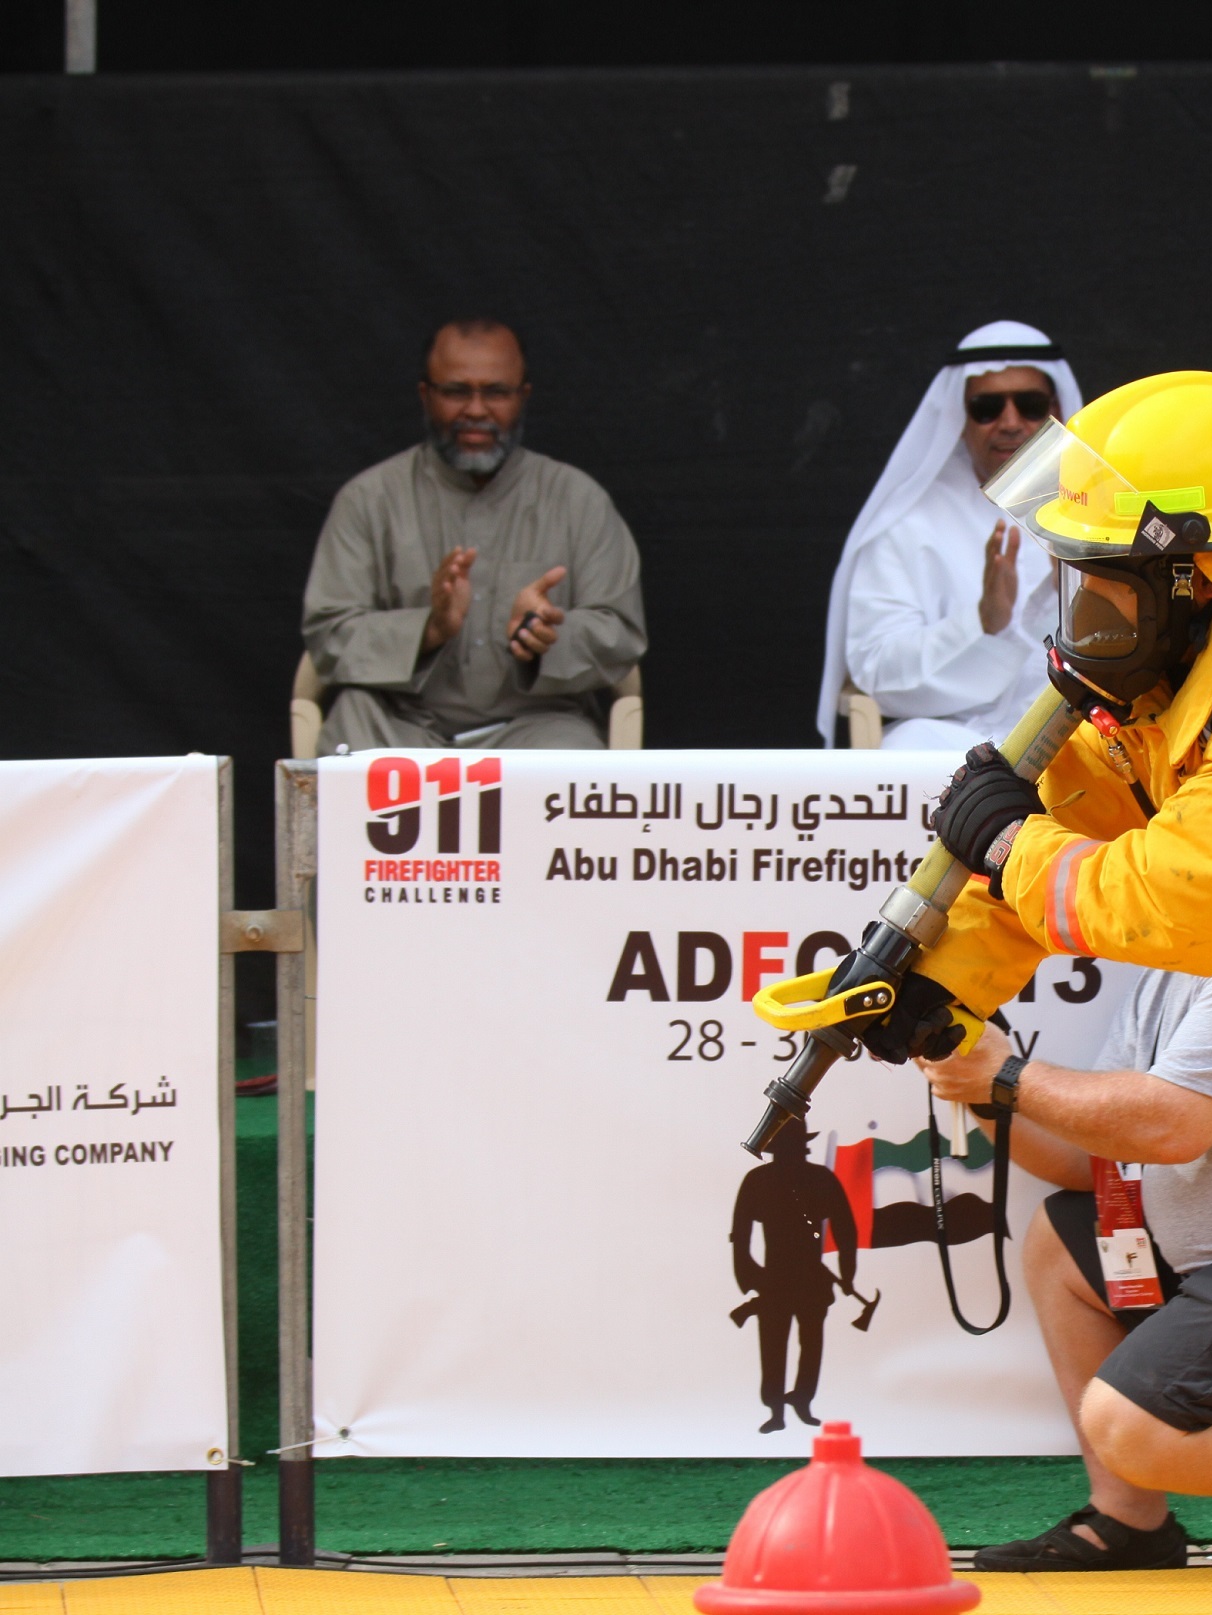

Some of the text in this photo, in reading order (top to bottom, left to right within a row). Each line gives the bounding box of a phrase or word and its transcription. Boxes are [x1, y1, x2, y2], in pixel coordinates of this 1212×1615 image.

[366, 757, 502, 855] 911
[545, 782, 682, 833] الإطفاء
[696, 783, 778, 830] رجال
[792, 783, 908, 842] لتحدي
[365, 860, 500, 882] FIREFIGHTER
[545, 848, 617, 881] Abu
[633, 848, 737, 881] Dhabi
[365, 887, 500, 903] CHALLENGE
[667, 1019, 725, 1062] 28
[0, 1075, 176, 1120] شركة الجر
[0, 1141, 174, 1167] ING COMPANY
